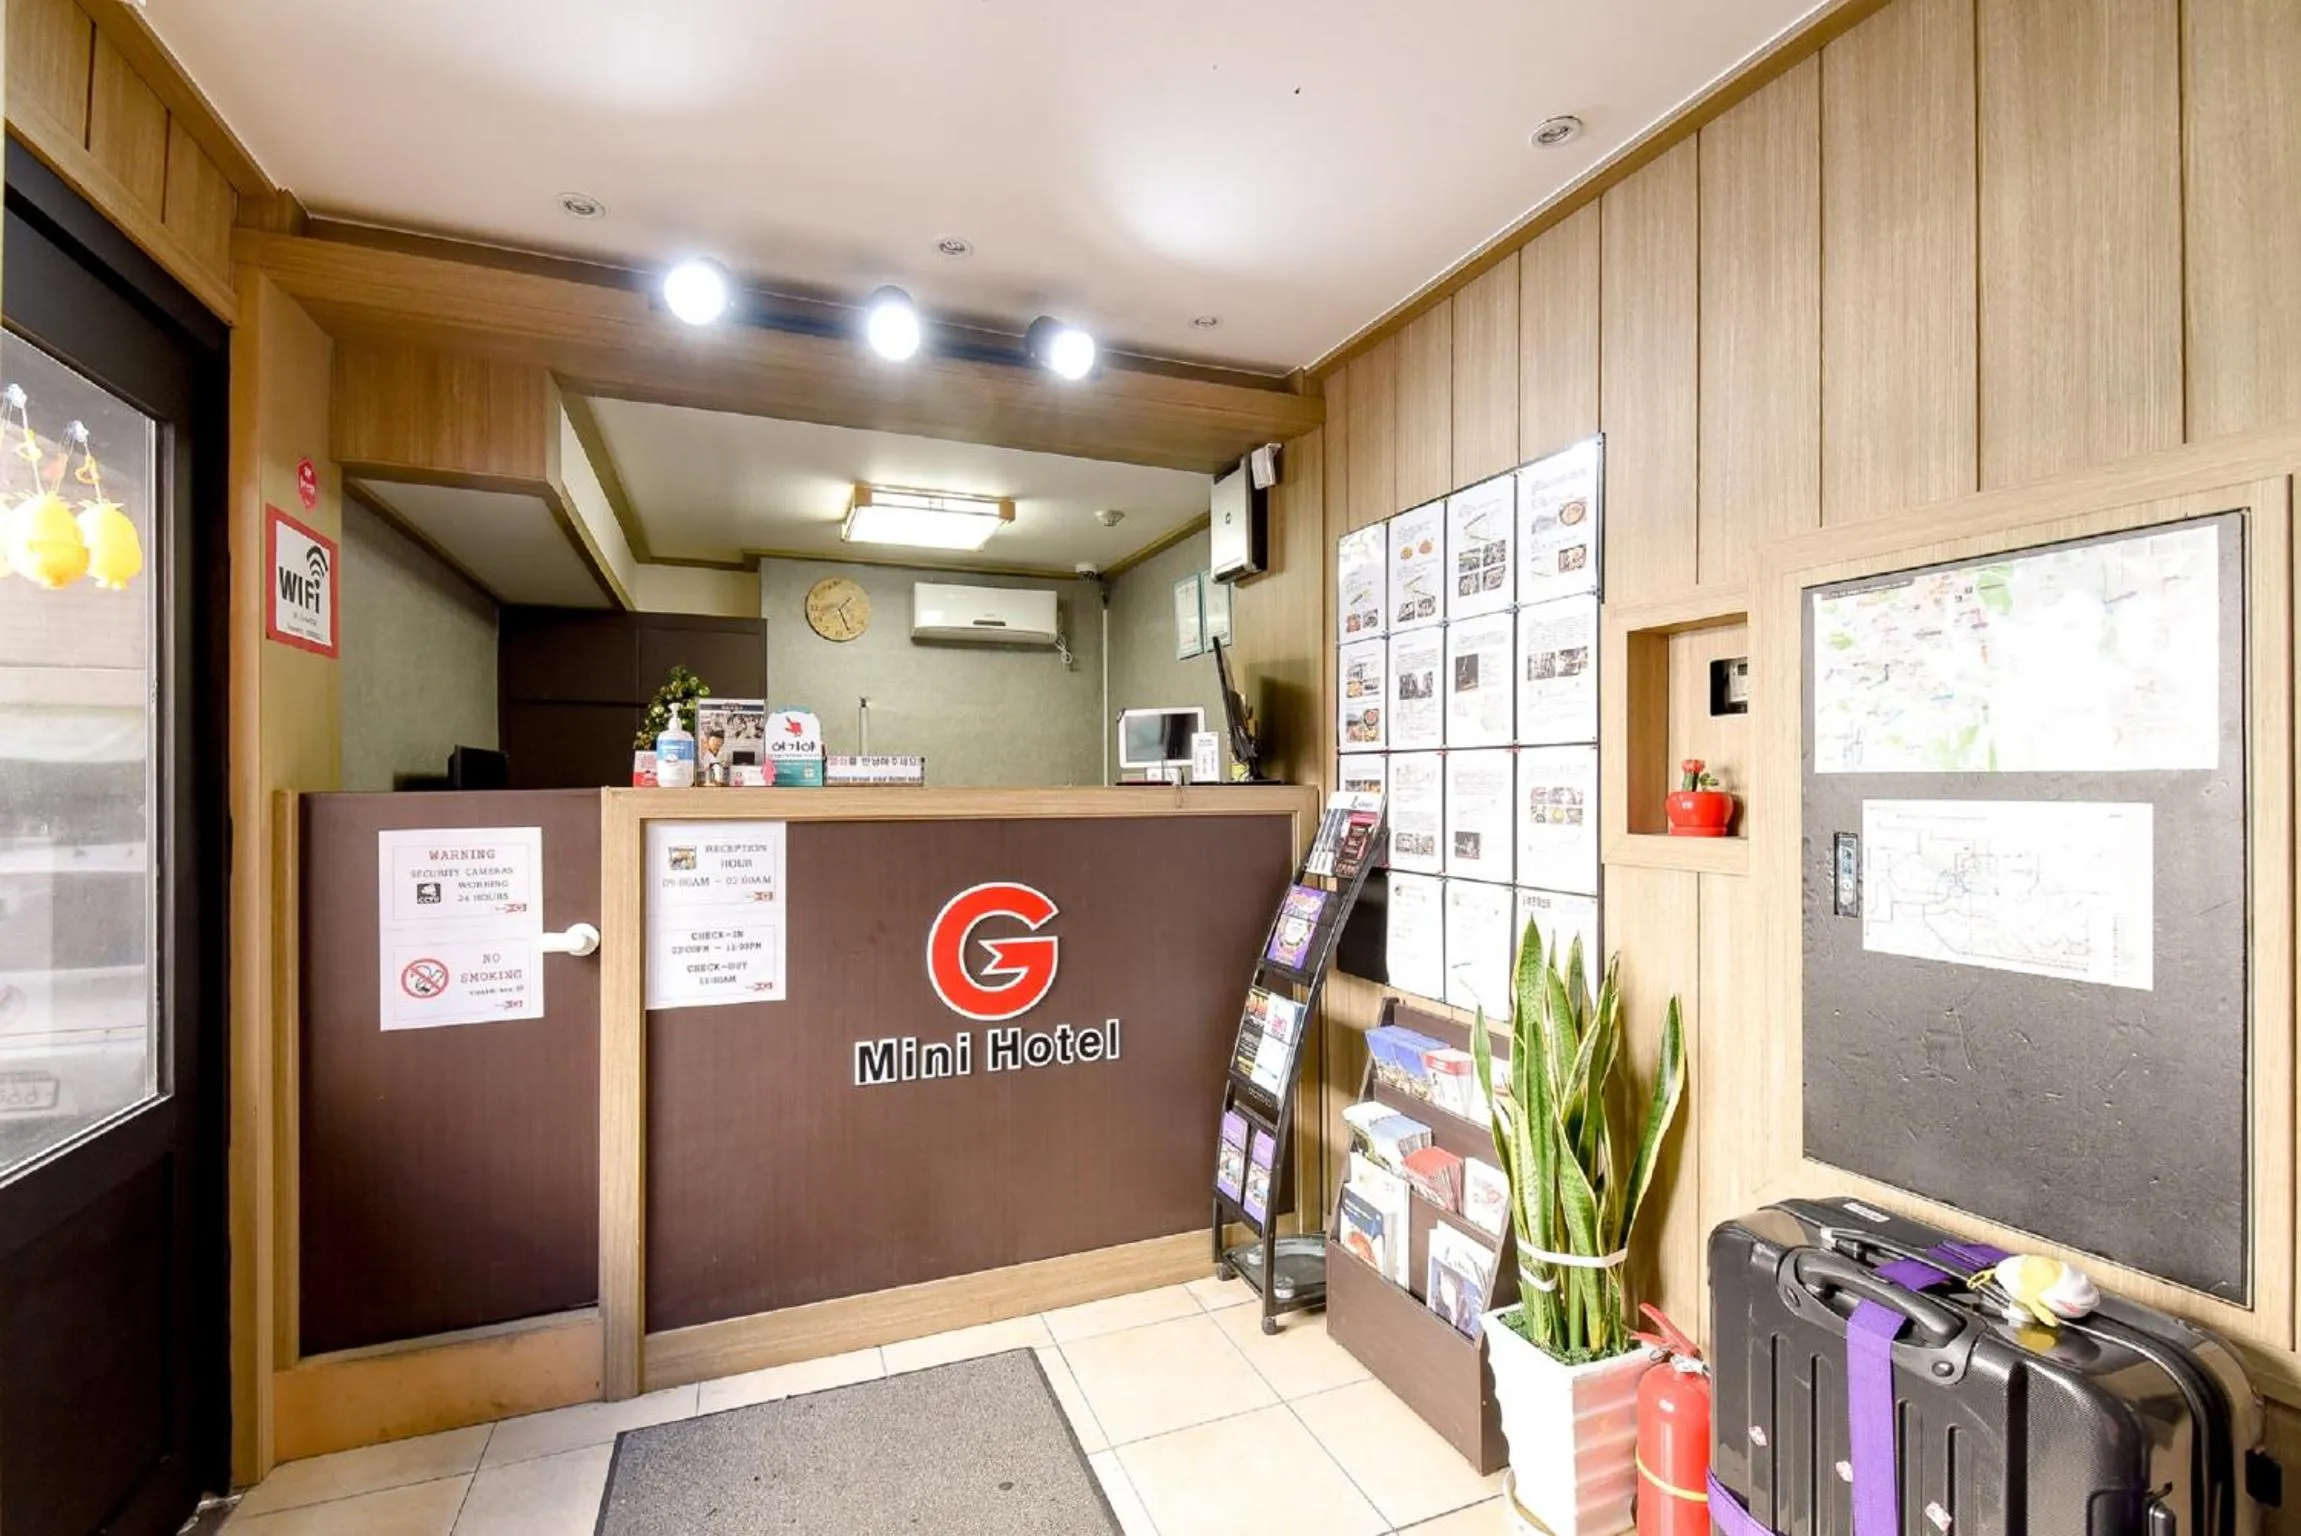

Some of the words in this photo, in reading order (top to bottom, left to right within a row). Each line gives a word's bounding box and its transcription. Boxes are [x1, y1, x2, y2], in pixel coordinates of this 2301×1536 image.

[704, 844, 767, 853] RECEPTION
[429, 849, 496, 861] WARNING
[720, 859, 753, 868] HOUR
[410, 869, 460, 878] SECURITY
[465, 867, 514, 877] CAMERAS
[458, 880, 509, 889] WORKING
[473, 893, 509, 902] HOURS
[691, 930, 744, 941] CHECK-IN
[927, 882, 1060, 1021] G
[482, 953, 501, 964] NO
[687, 962, 748, 973] CHECK-OUT
[460, 969, 523, 984] SMOKING
[855, 1031, 971, 1085] Mini
[987, 1018, 1120, 1072] Hotel
